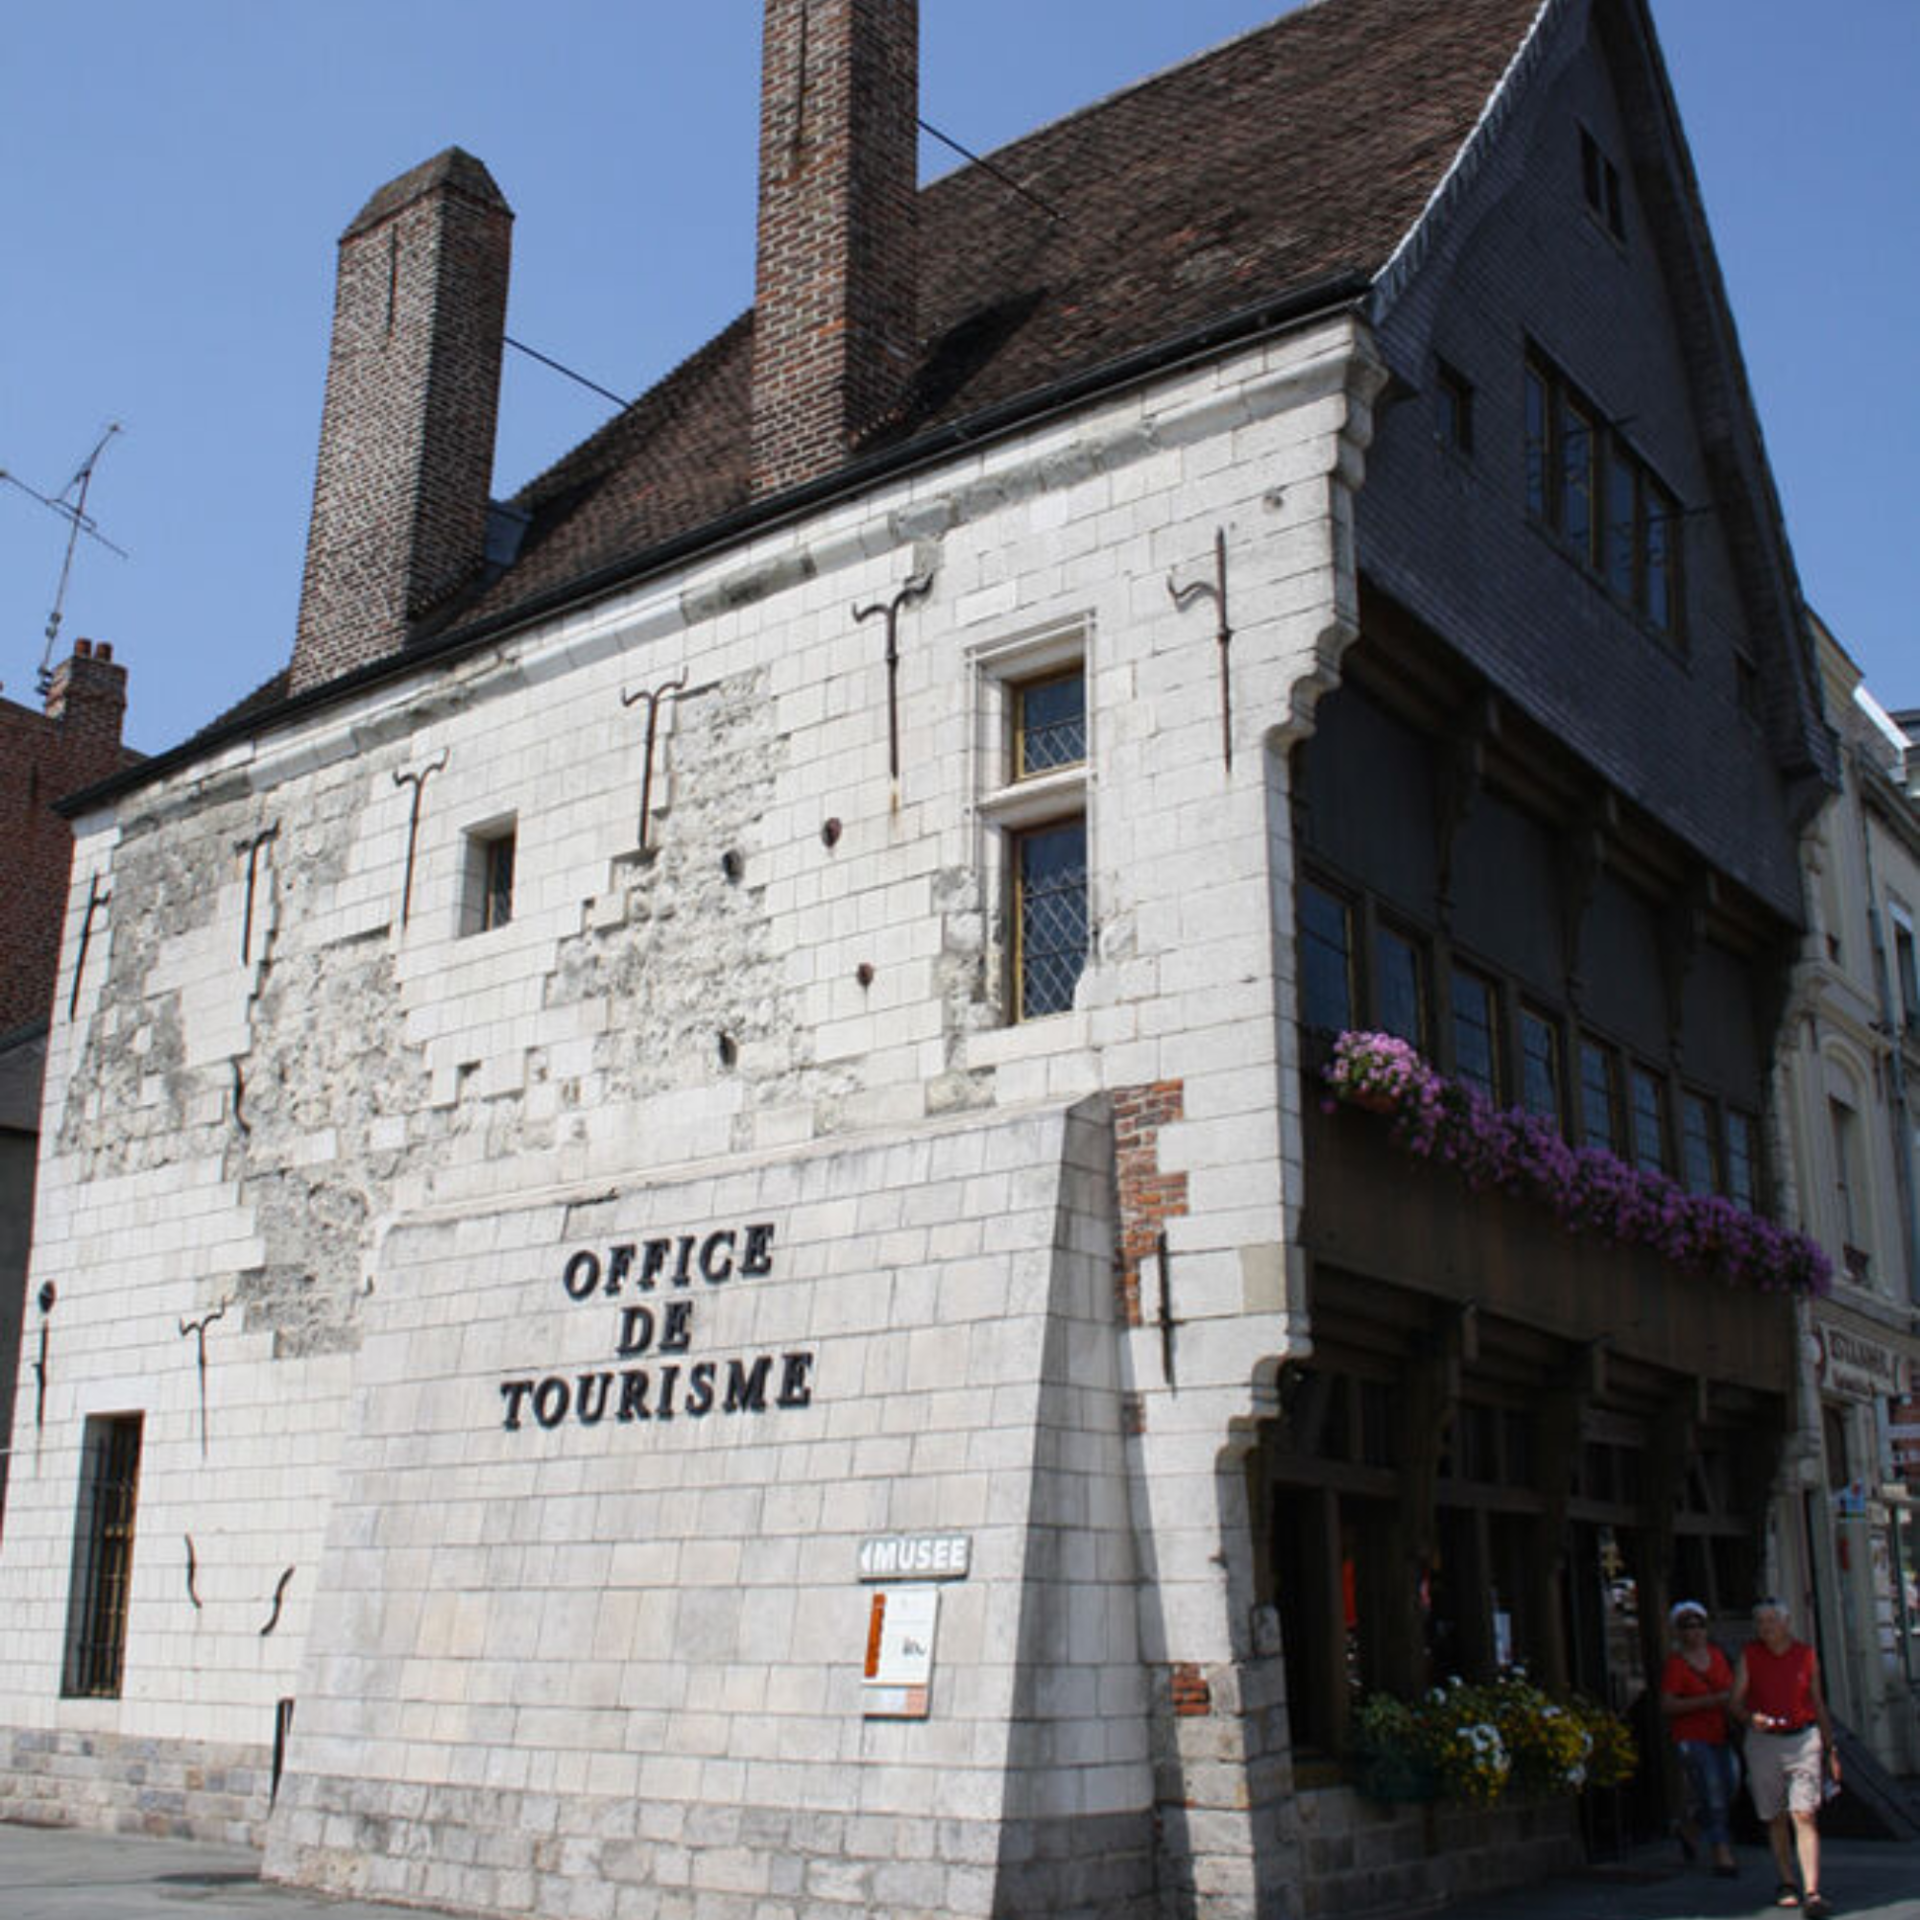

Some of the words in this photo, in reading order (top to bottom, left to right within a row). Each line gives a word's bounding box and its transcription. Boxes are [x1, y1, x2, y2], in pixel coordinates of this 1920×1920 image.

[563, 1223, 775, 1301] OFFICE
[616, 1300, 693, 1356] DE
[500, 1352, 814, 1431] TOURISME
[873, 1537, 967, 1573] MUSEE
